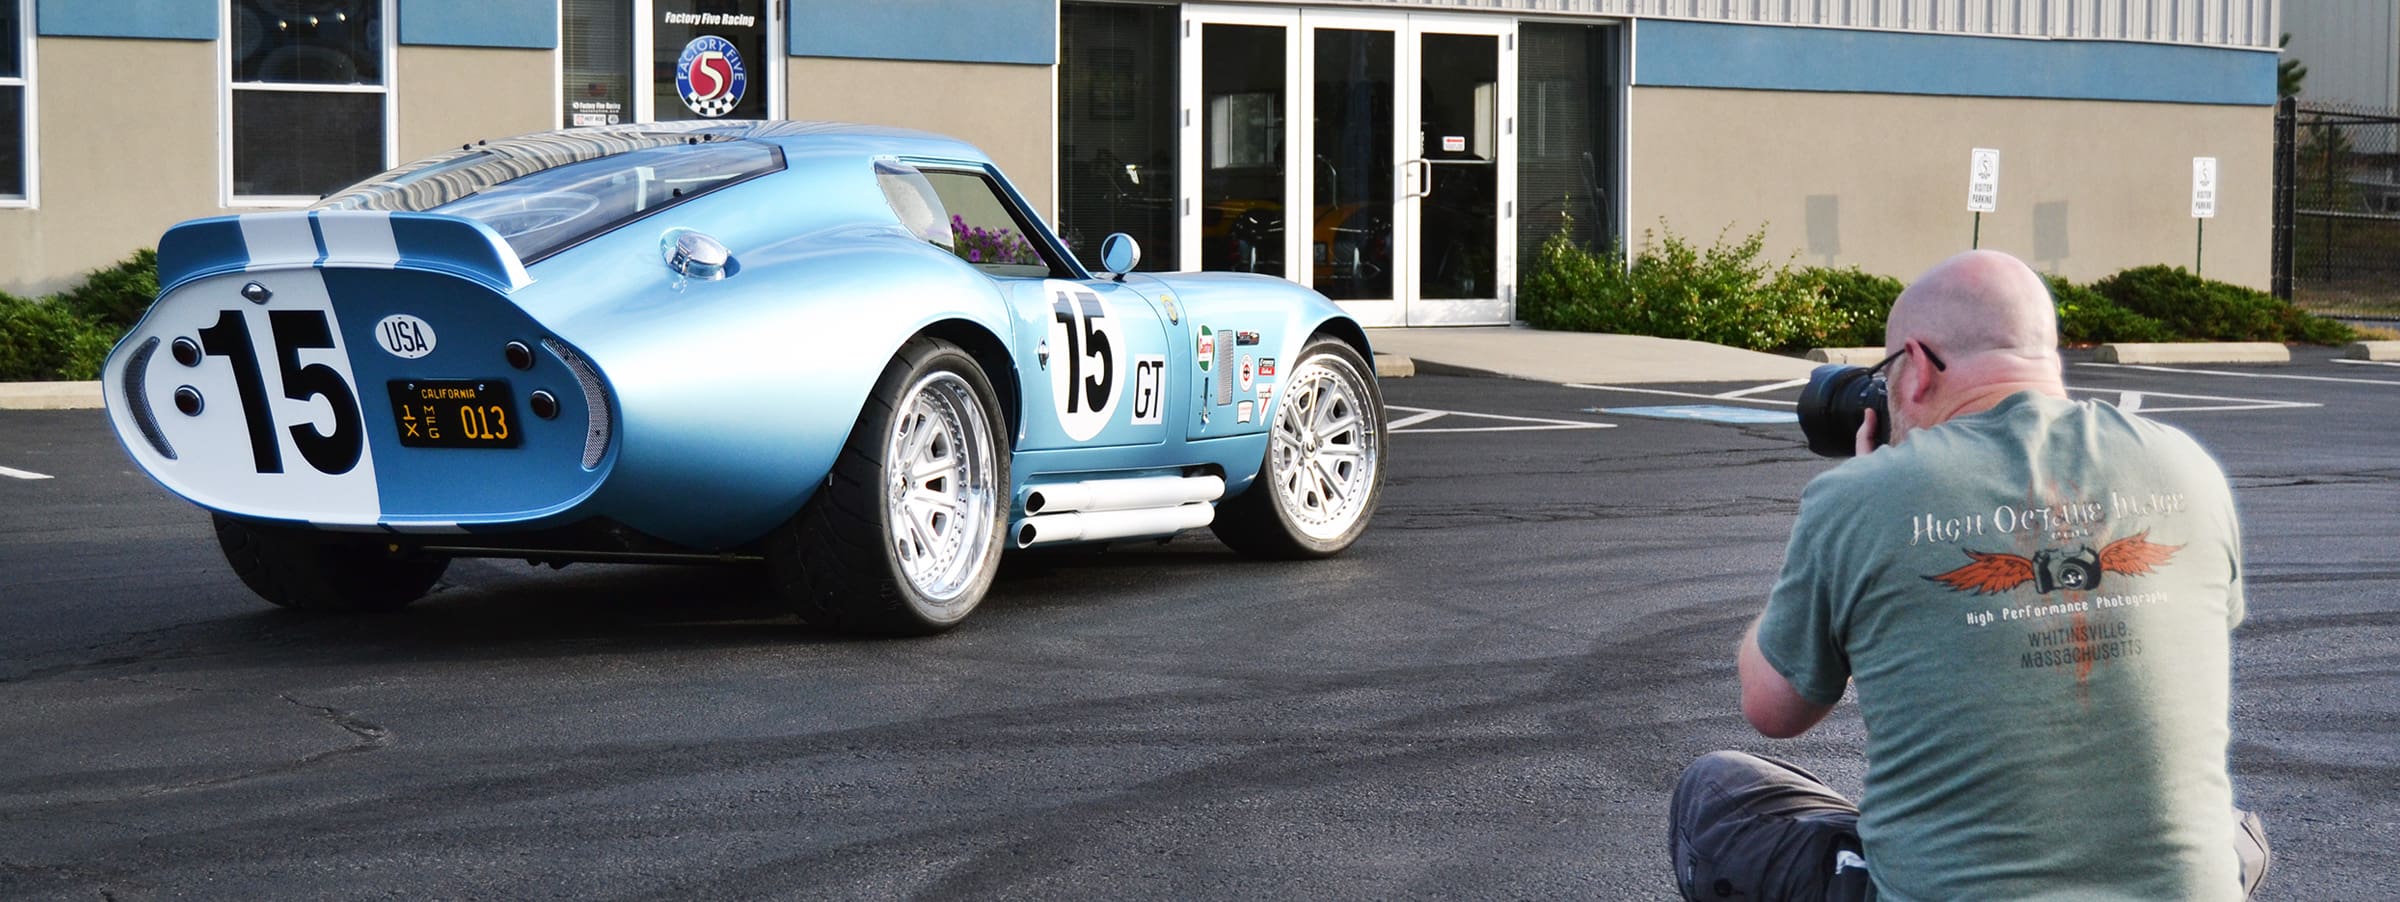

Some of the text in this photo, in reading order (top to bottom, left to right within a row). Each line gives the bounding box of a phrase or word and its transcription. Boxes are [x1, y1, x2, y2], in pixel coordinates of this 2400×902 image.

[664, 12, 755, 27] Factory Five Racing
[678, 38, 744, 81] FACTORY FIVE
[698, 50, 724, 101] 5
[1972, 193, 1993, 204] PARKING
[1974, 183, 1993, 193] VISITOR
[384, 320, 428, 352] USA
[1053, 291, 1113, 414] 15
[198, 310, 364, 475] 15
[420, 388, 476, 400] CALIFORNIA
[1134, 361, 1164, 418] GT
[460, 405, 509, 440] 013
[1966, 590, 2169, 627] High Performance Photography
